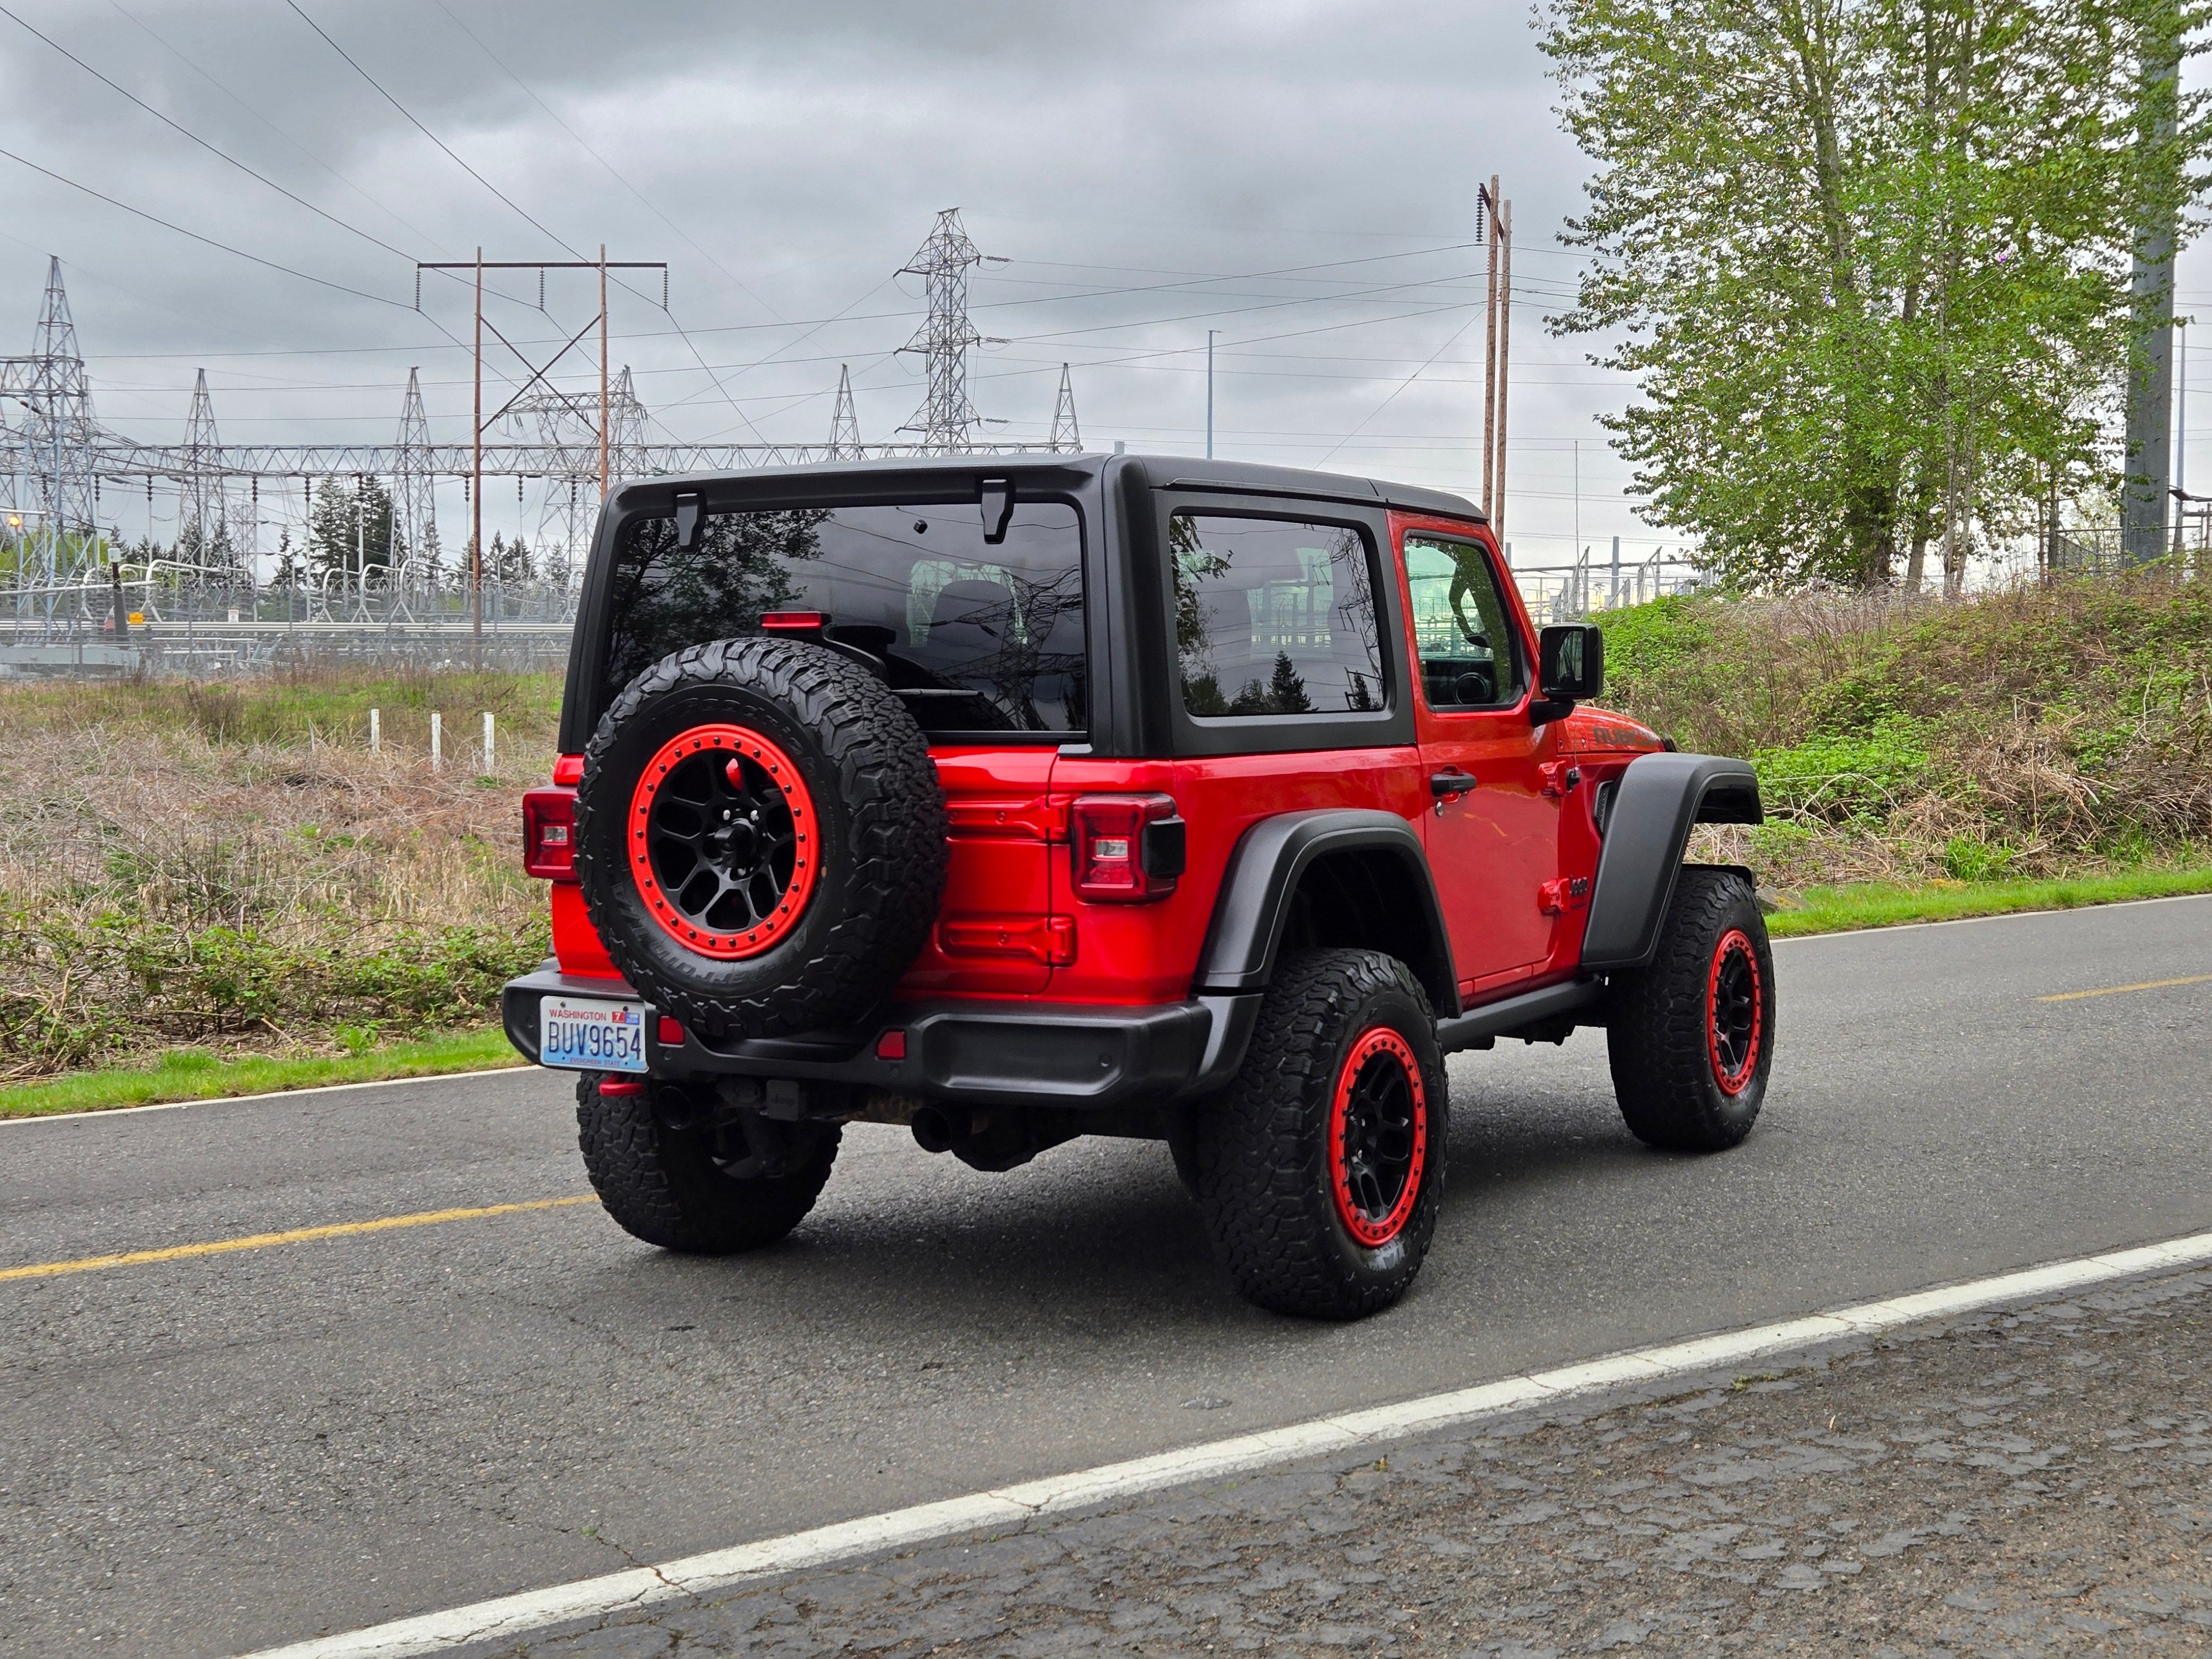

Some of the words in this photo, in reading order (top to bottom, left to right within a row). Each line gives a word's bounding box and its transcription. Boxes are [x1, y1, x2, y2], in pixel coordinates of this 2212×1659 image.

[549, 1009, 607, 1021] WASHINGTON
[614, 1012, 621, 1021] 7
[549, 1021, 641, 1061] BUV9654
[570, 1057, 602, 1065] EVERGREEN
